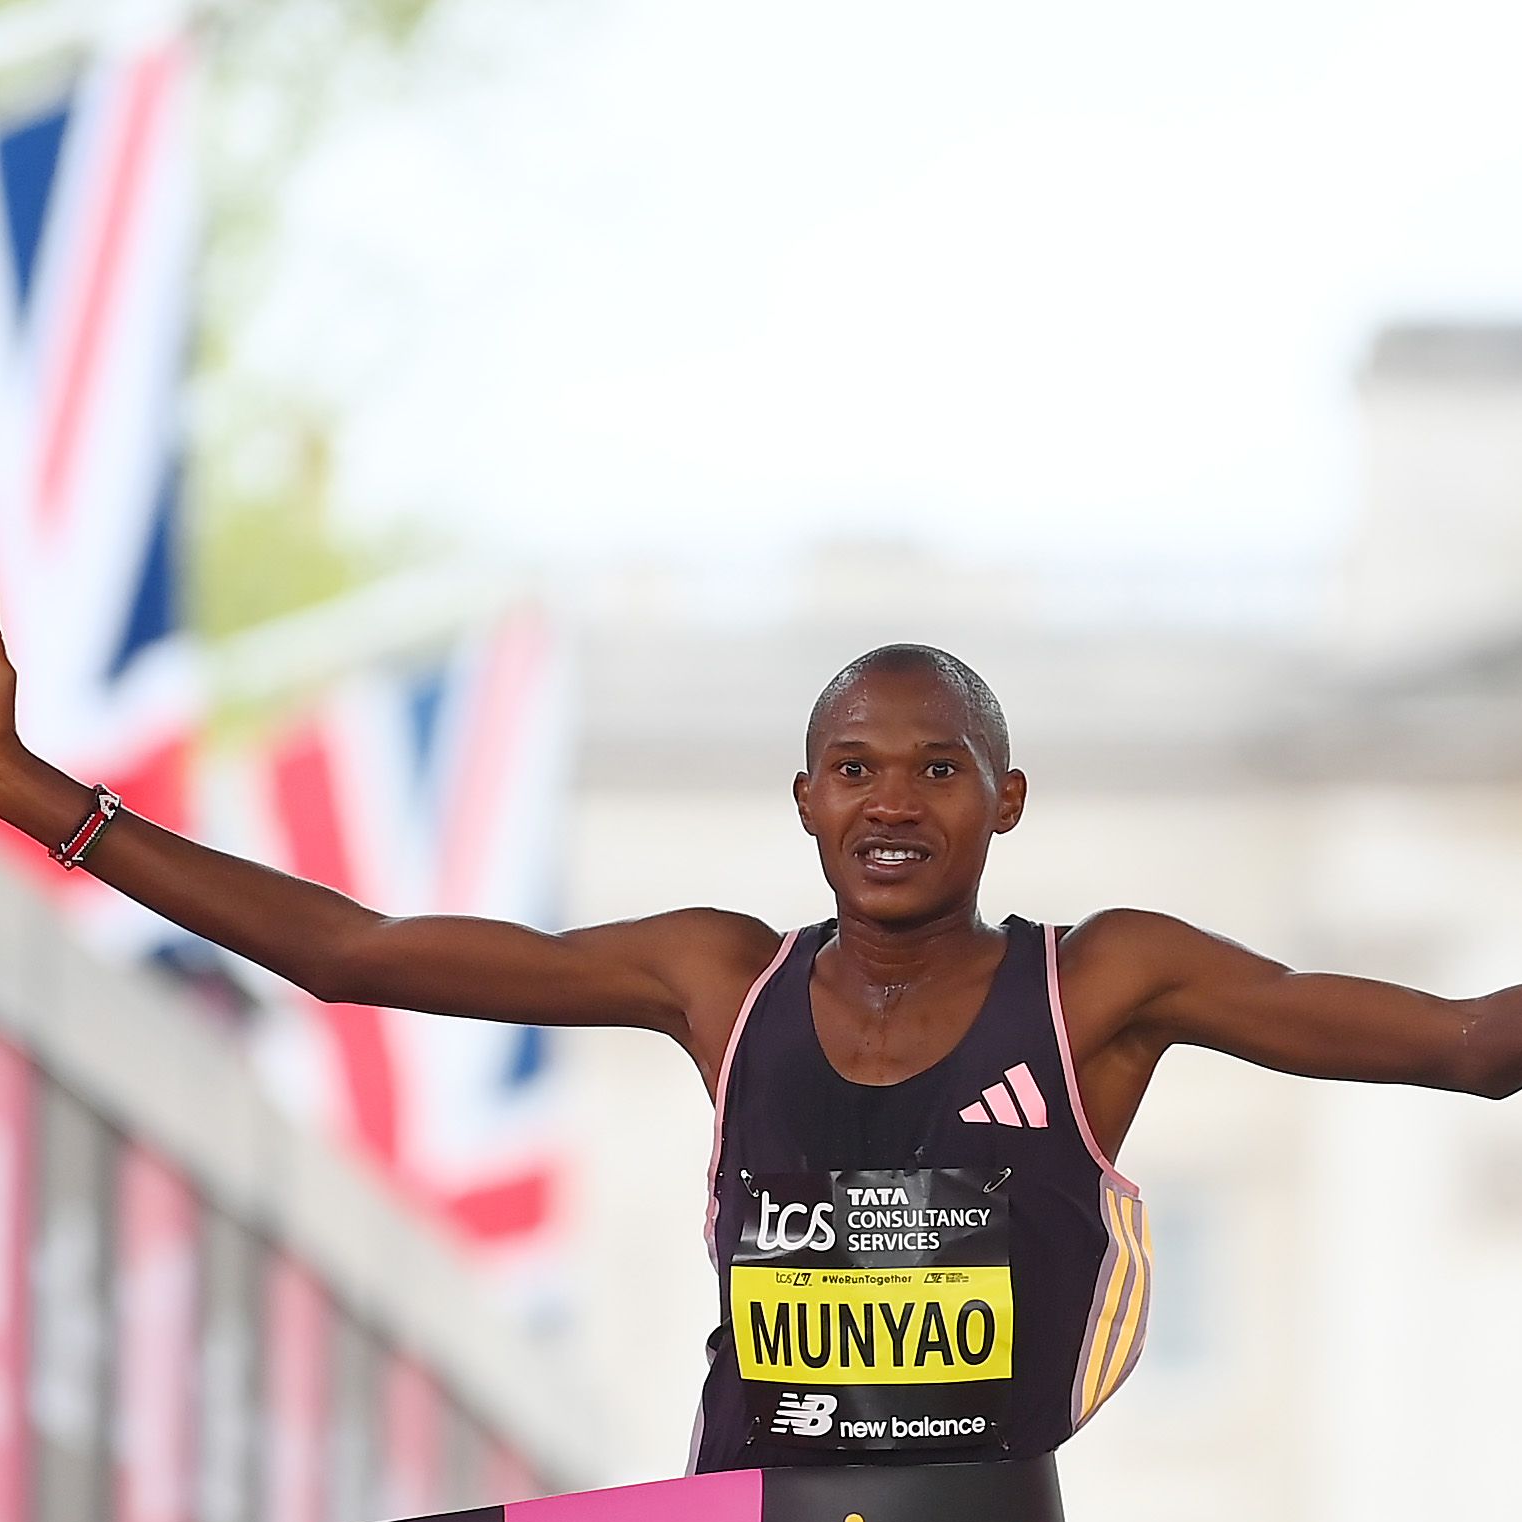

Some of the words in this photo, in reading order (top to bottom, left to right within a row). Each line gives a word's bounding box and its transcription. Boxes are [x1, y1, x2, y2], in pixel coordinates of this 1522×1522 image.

[847, 1187, 910, 1206] TATA
[756, 1190, 836, 1251] tcs
[847, 1208, 991, 1229] CONSULTANCY
[847, 1232, 940, 1251] SERVICES
[750, 1299, 996, 1368] MUNYAO
[840, 1421, 887, 1438] new
[892, 1416, 986, 1437] balance
